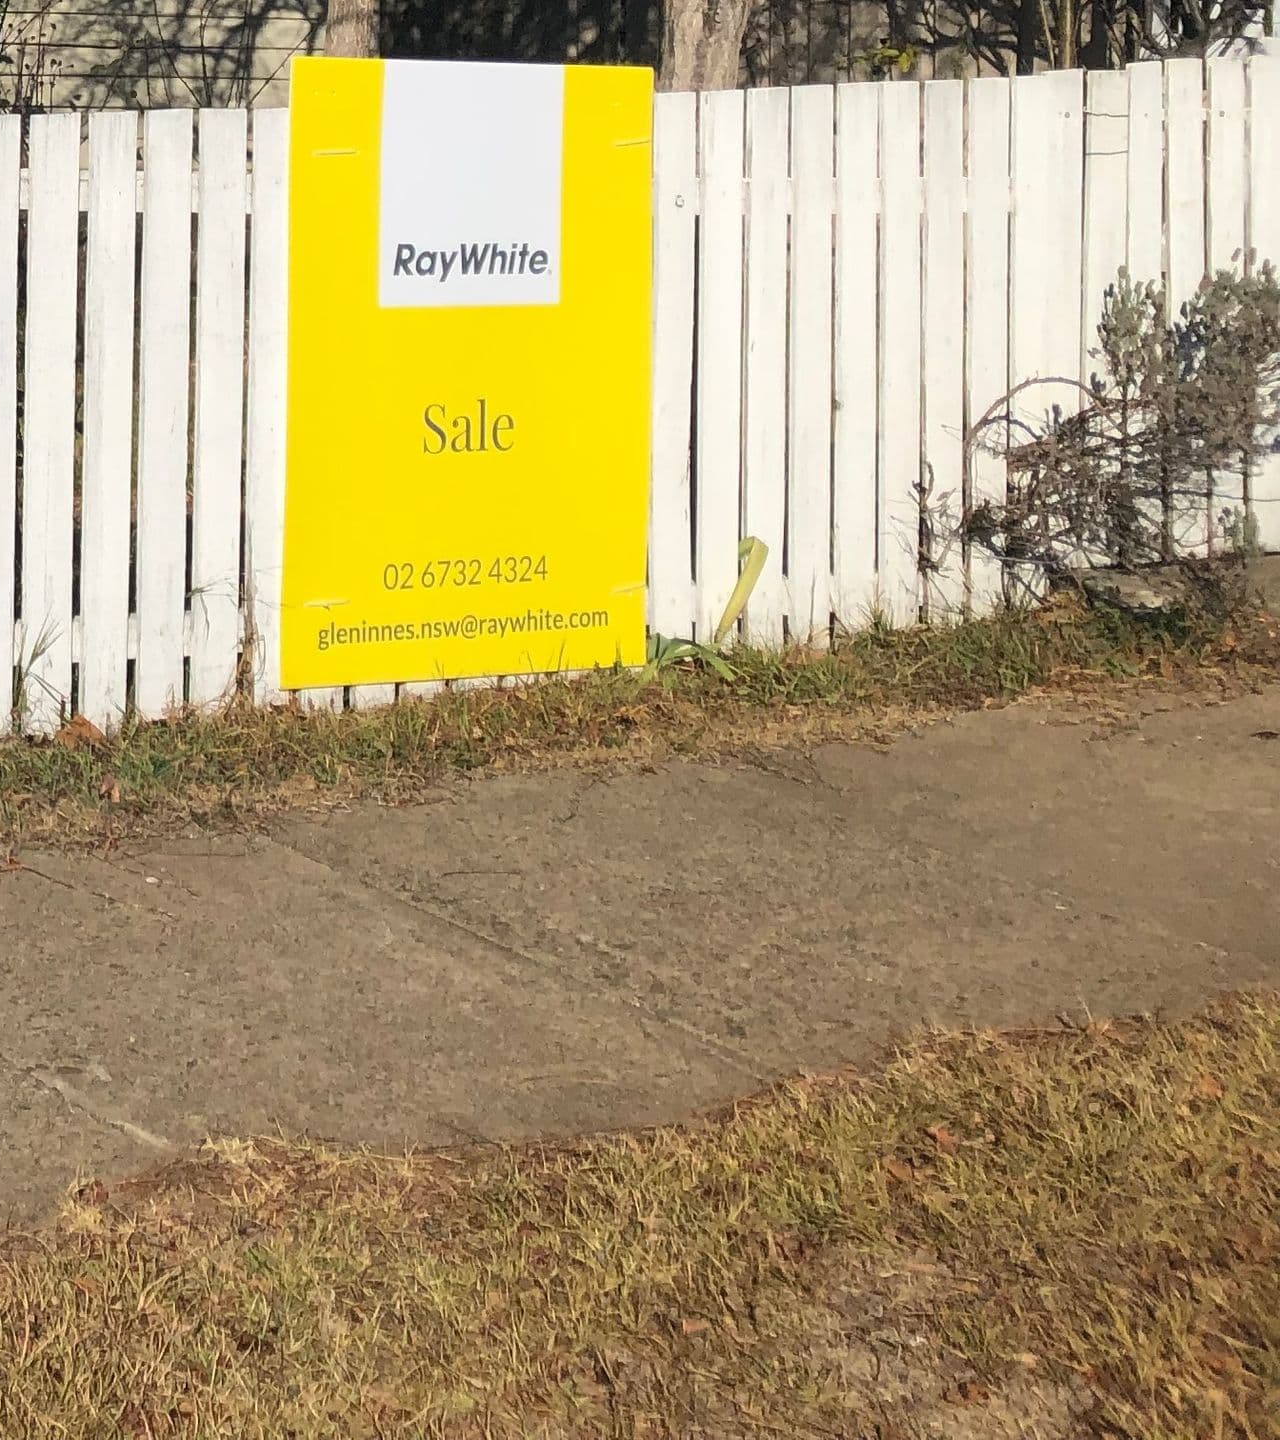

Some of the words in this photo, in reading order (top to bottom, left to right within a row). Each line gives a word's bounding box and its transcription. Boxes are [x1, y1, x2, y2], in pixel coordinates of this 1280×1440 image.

[423, 398, 514, 455] Sale
[383, 562, 414, 591] 02
[421, 559, 482, 589] 6732
[487, 555, 549, 584] 4324
[317, 608, 609, 651] gleninnes.nsw@raywhite.com
